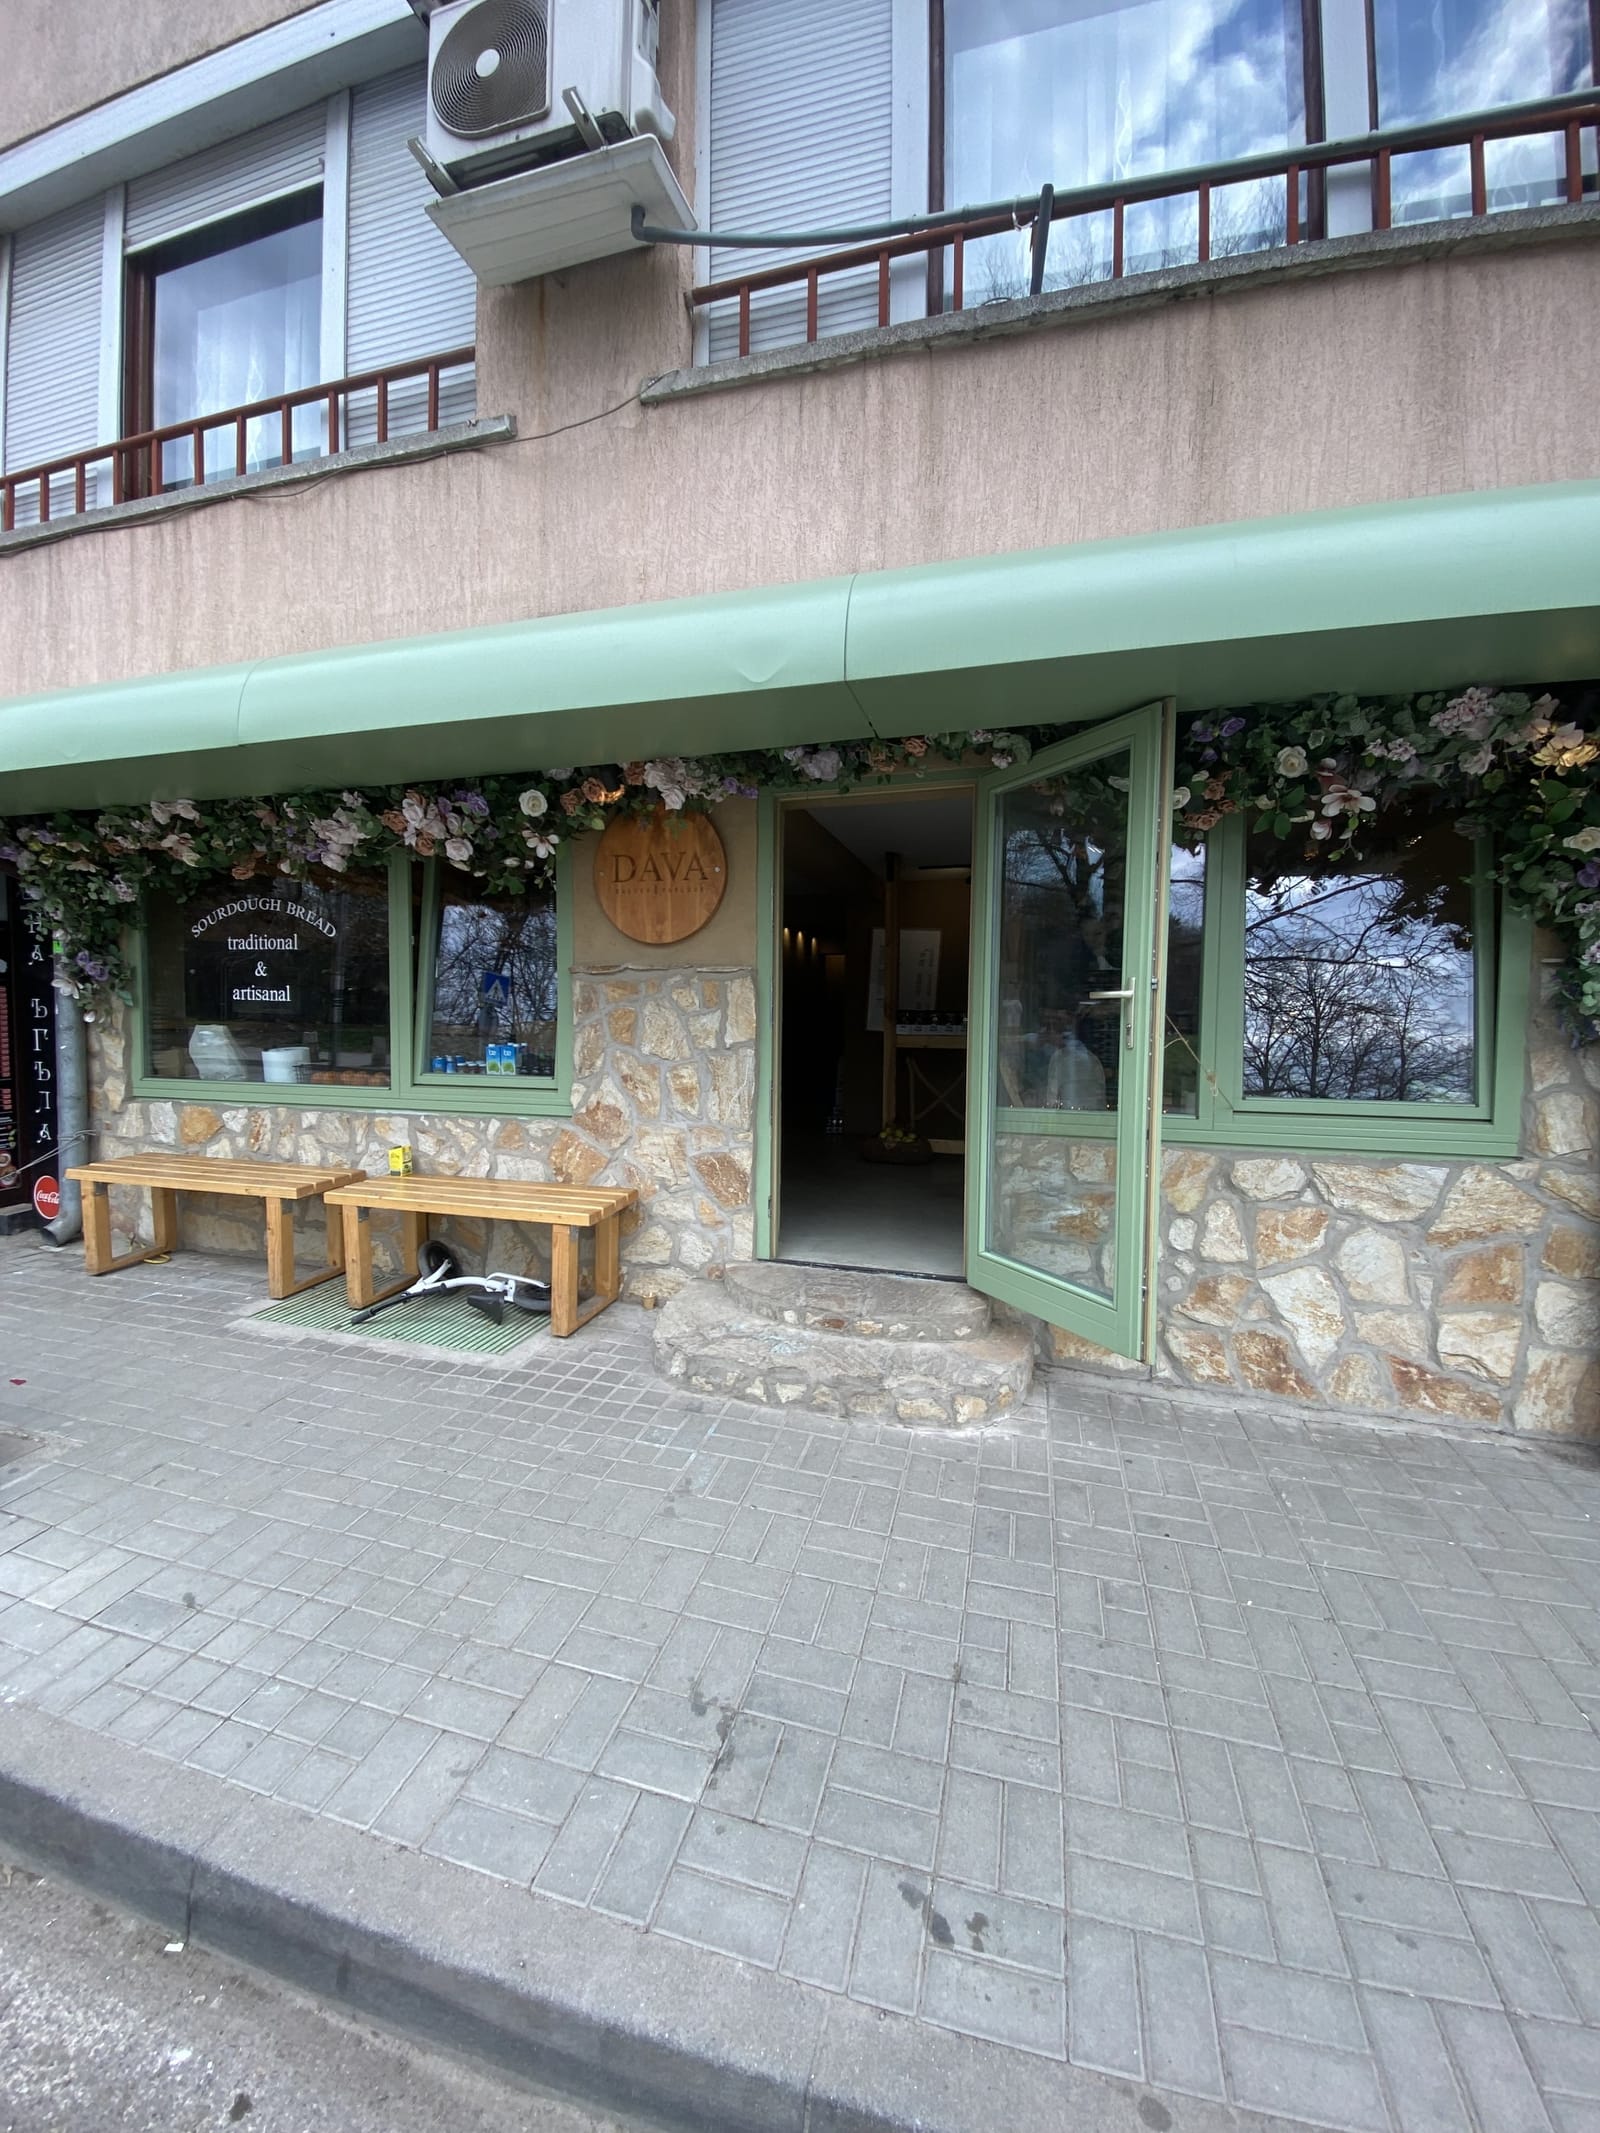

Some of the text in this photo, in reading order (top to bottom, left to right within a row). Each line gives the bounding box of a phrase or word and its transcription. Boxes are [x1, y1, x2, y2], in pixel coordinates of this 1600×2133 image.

[611, 851, 708, 883] DAVA
[191, 897, 336, 937] SOURDOUGH BREAD
[228, 934, 298, 950] traditional
[254, 961, 268, 977] &
[232, 985, 291, 1002] artisanal
[30, 998, 52, 1144] ЪГЪЛА
